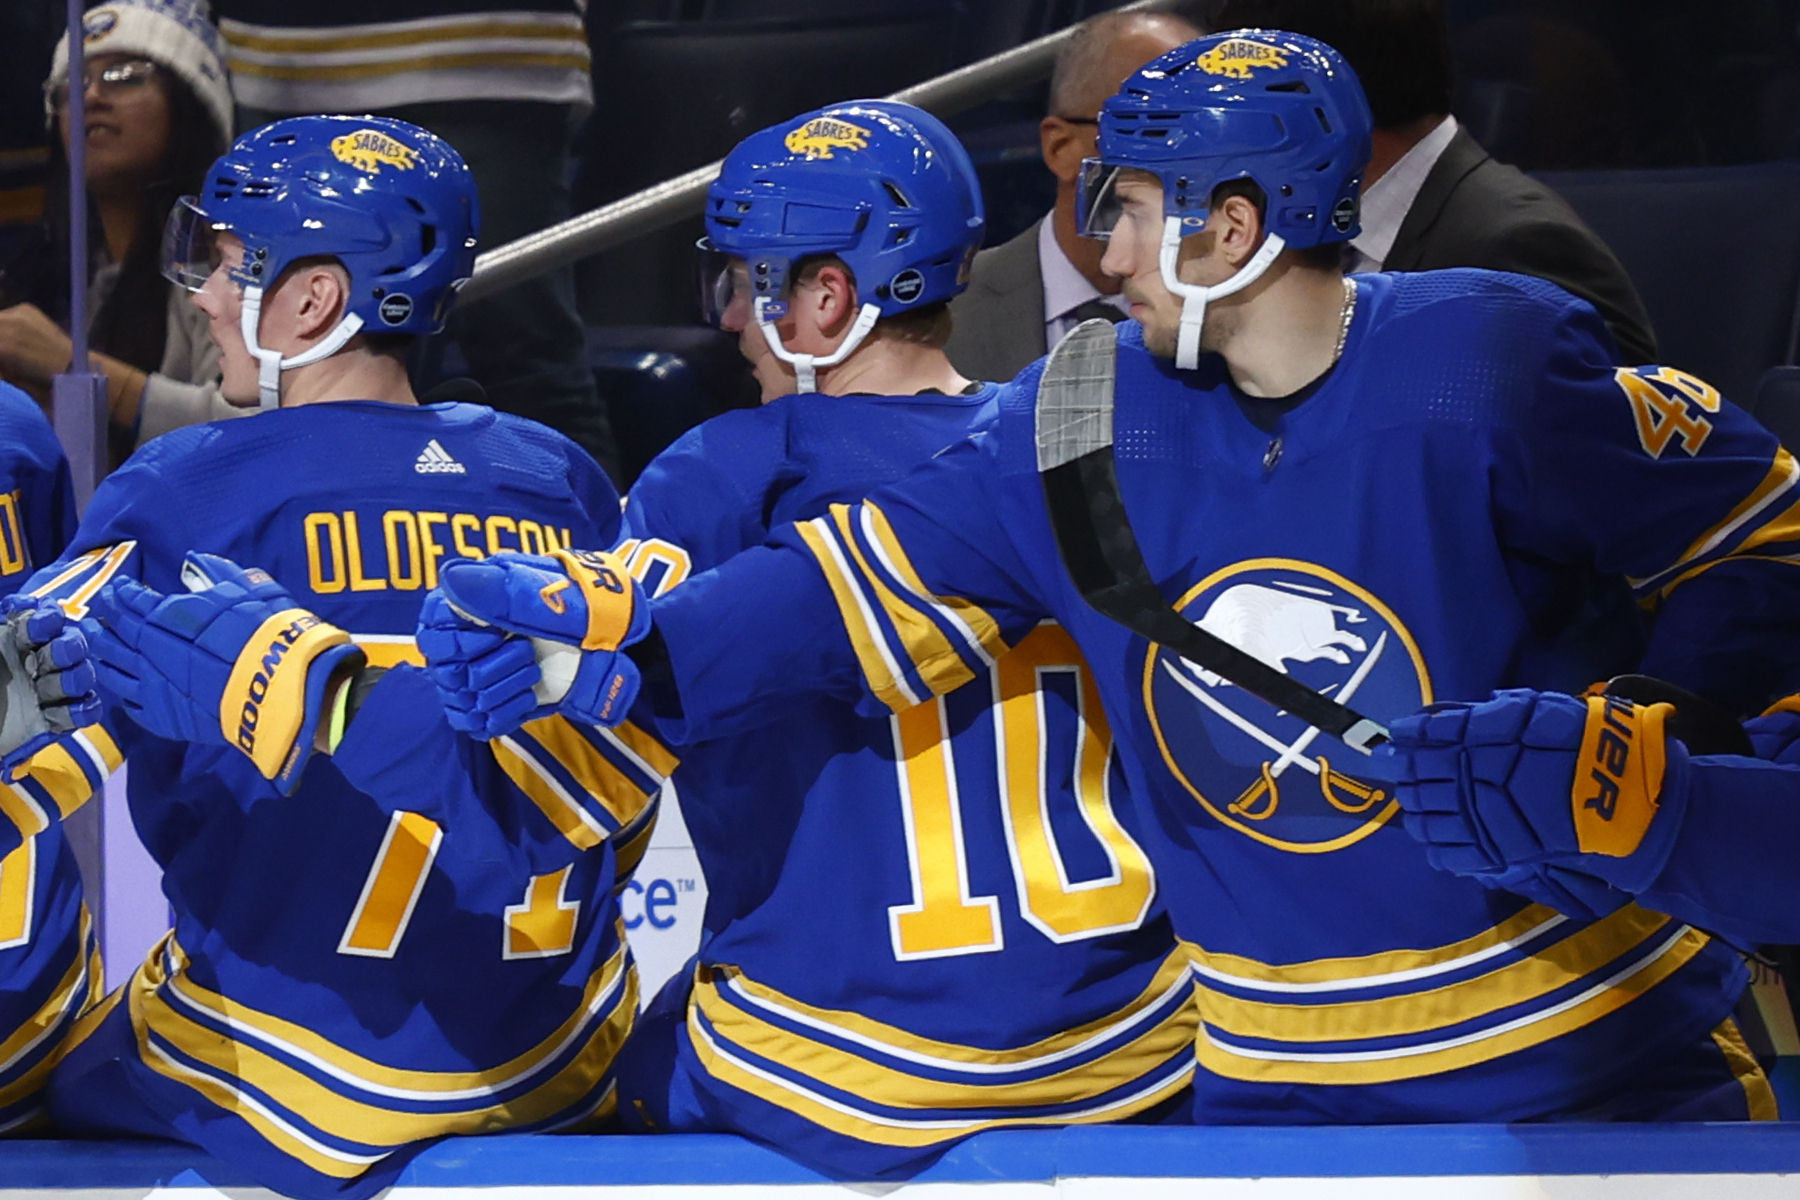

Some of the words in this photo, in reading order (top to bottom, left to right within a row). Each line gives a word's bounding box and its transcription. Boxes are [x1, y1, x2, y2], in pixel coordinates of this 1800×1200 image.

[1218, 43, 1270, 60] SABRES
[805, 120, 852, 140] SABRES
[350, 133, 400, 158] SABRES
[414, 461, 466, 475] adidas
[887, 618, 1156, 963] 10
